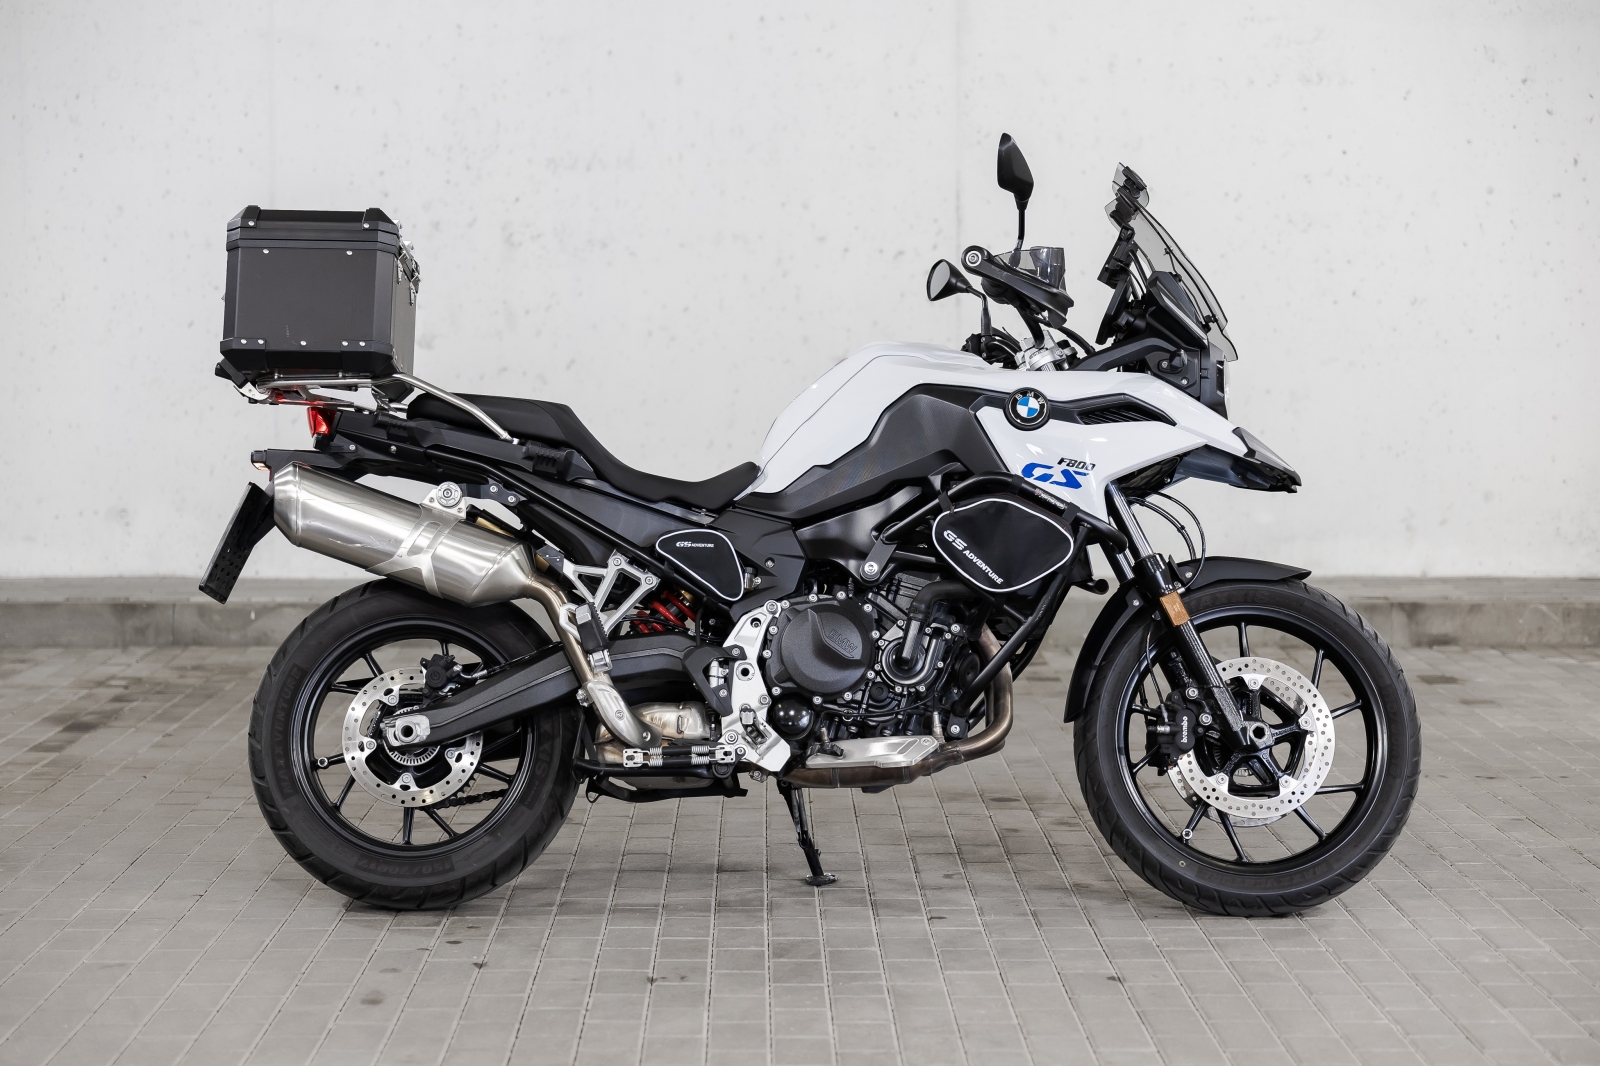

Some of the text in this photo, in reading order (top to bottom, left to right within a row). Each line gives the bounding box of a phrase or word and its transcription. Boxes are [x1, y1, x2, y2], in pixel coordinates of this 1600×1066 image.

[1015, 391, 1045, 405] BMW
[1021, 462, 1089, 489] GS
[1057, 456, 1096, 472] F800
[943, 529, 1004, 585] GS ADVENTURE
[828, 629, 858, 654] BMW
[1180, 715, 1188, 743] brembo
